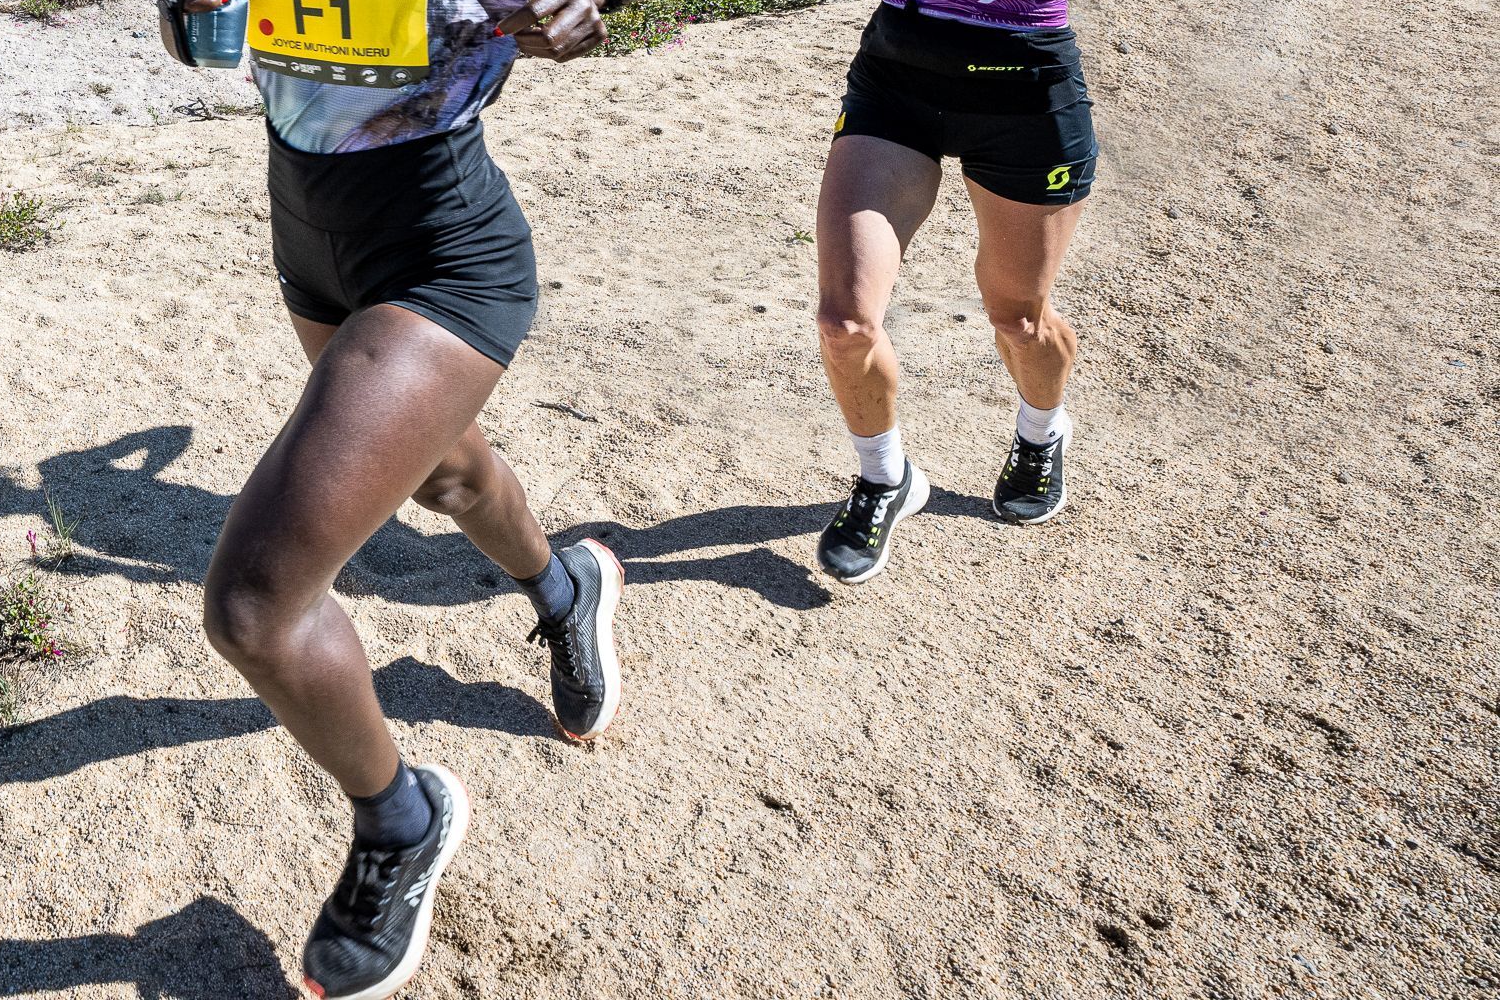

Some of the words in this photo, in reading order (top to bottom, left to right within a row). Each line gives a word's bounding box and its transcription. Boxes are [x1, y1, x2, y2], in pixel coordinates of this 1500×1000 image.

[271, 38, 301, 50] JOYCE
[303, 42, 349, 56] MUTHONI
[351, 47, 390, 58] NJERU
